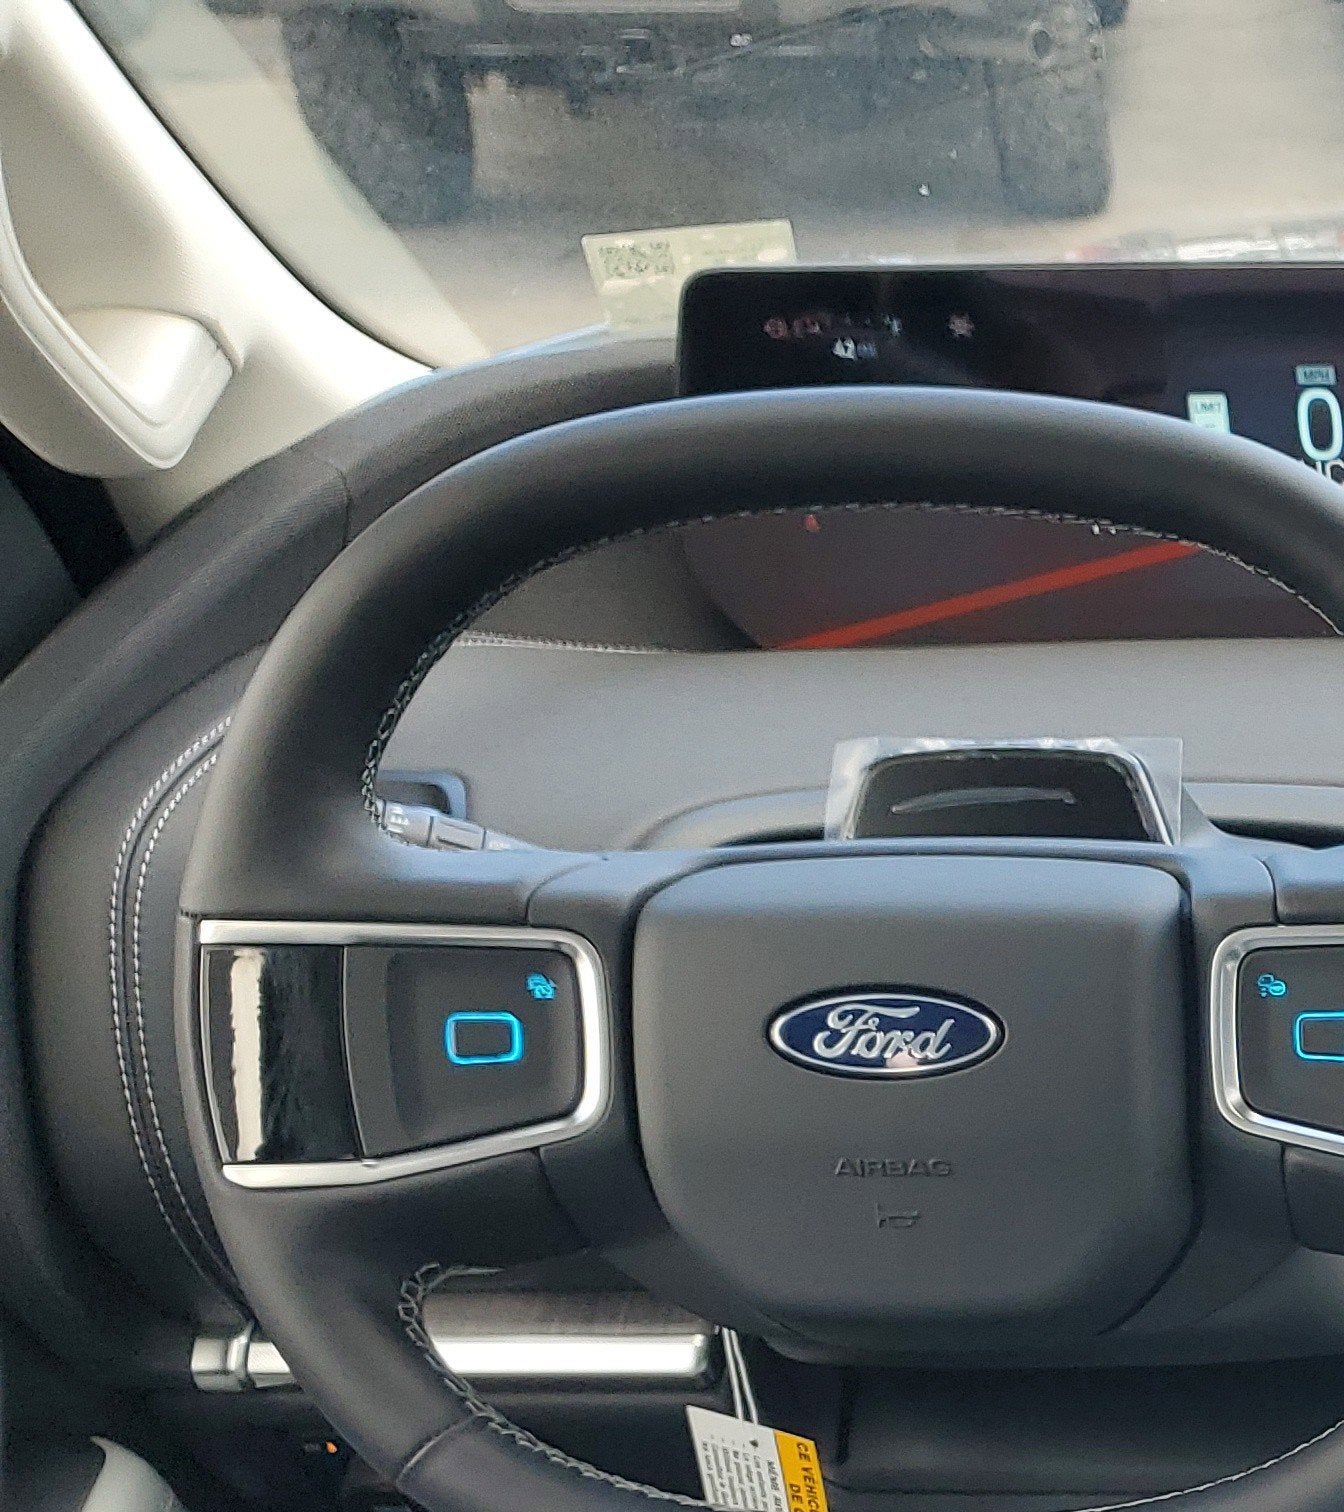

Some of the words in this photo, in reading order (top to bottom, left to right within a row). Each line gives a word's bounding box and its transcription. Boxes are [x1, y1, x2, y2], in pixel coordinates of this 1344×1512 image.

[1297, 387, 1344, 461] 0
[813, 1003, 955, 1059] Ford
[834, 1157, 953, 1178] AIRBAG
